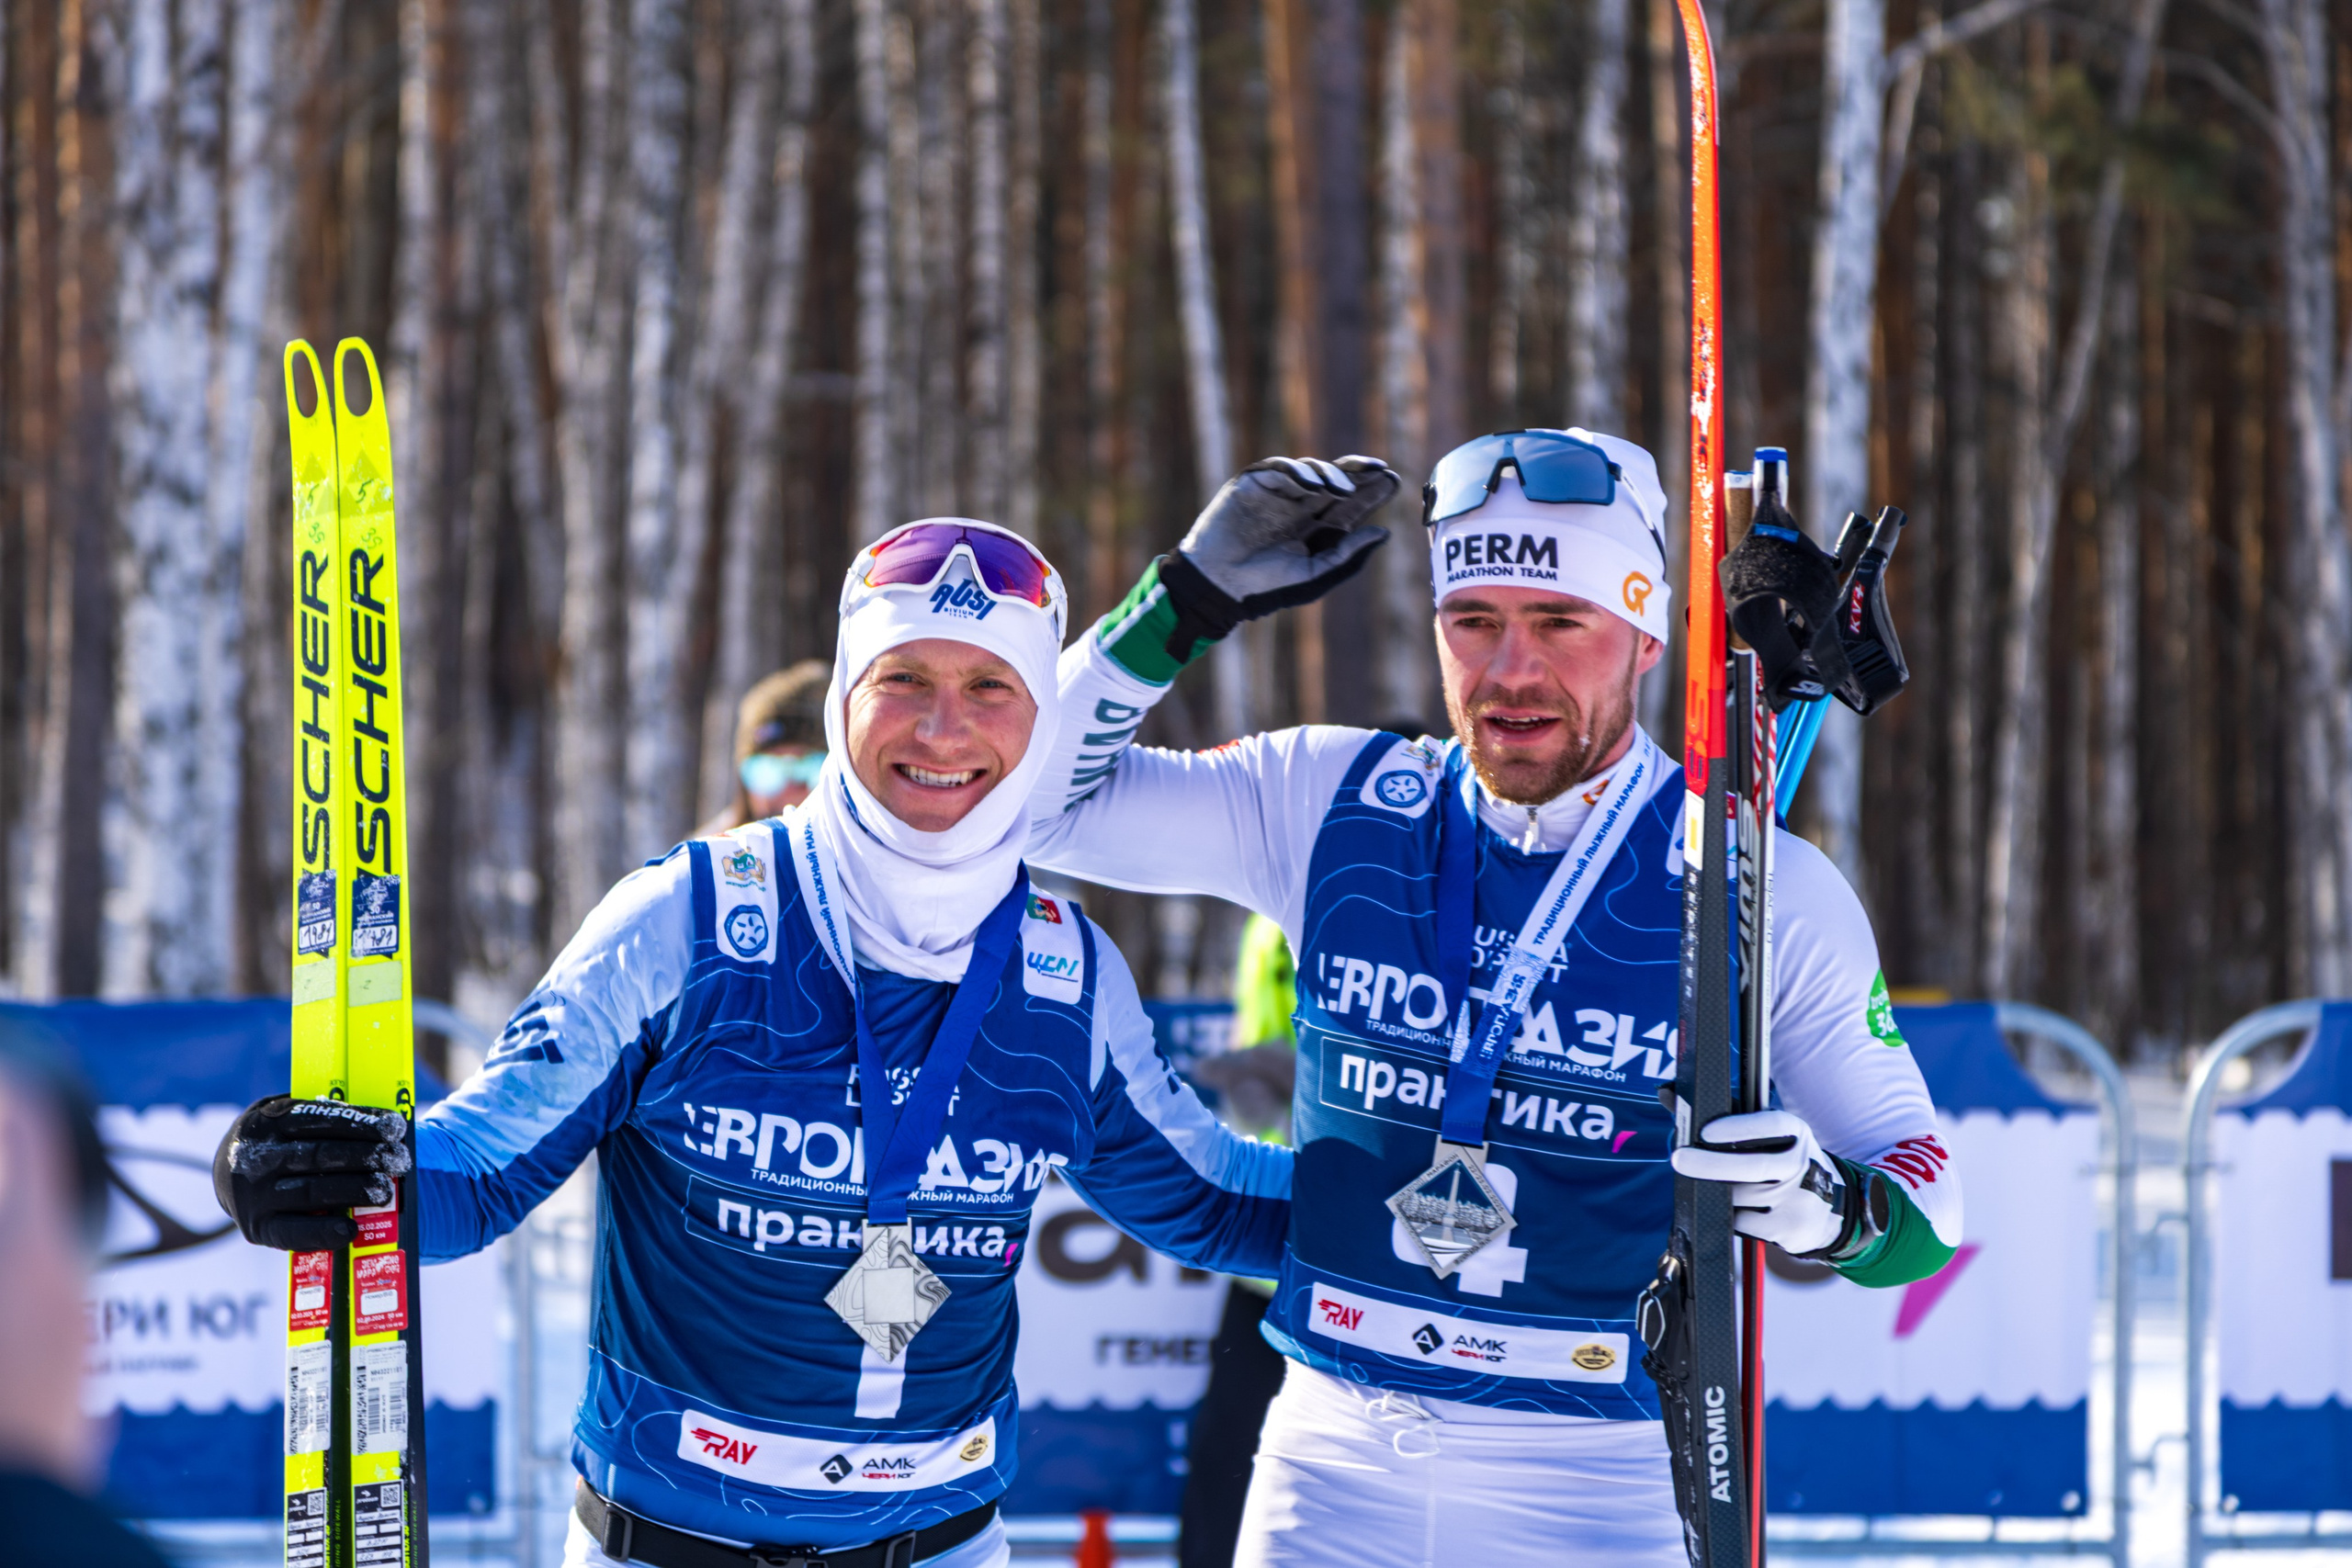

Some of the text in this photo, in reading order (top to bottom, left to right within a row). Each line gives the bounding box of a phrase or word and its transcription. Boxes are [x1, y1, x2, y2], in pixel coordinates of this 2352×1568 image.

[1446, 534, 1559, 572] PERM
[1446, 566, 1558, 583] MARATHON TEAM
[300, 549, 330, 879] SCHER
[349, 547, 391, 879] SCHER
[1532, 762, 1645, 947] ТРАДИЦИОННЫЙ ЛЫЖНЫЙ МАРАФОН
[807, 851, 829, 907] ЛЫЖНЫЙ
[1549, 1059, 1626, 1082] МАРАФОН
[956, 1192, 1014, 1204] МАРАФОН
[188, 1293, 268, 1340] ЮГ
[1318, 1299, 1363, 1331] RAY
[1453, 1334, 1509, 1355] АМК
[690, 1427, 759, 1465] RAY
[1703, 1384, 1733, 1504] ATOMIC
[862, 1457, 917, 1471] АМК
